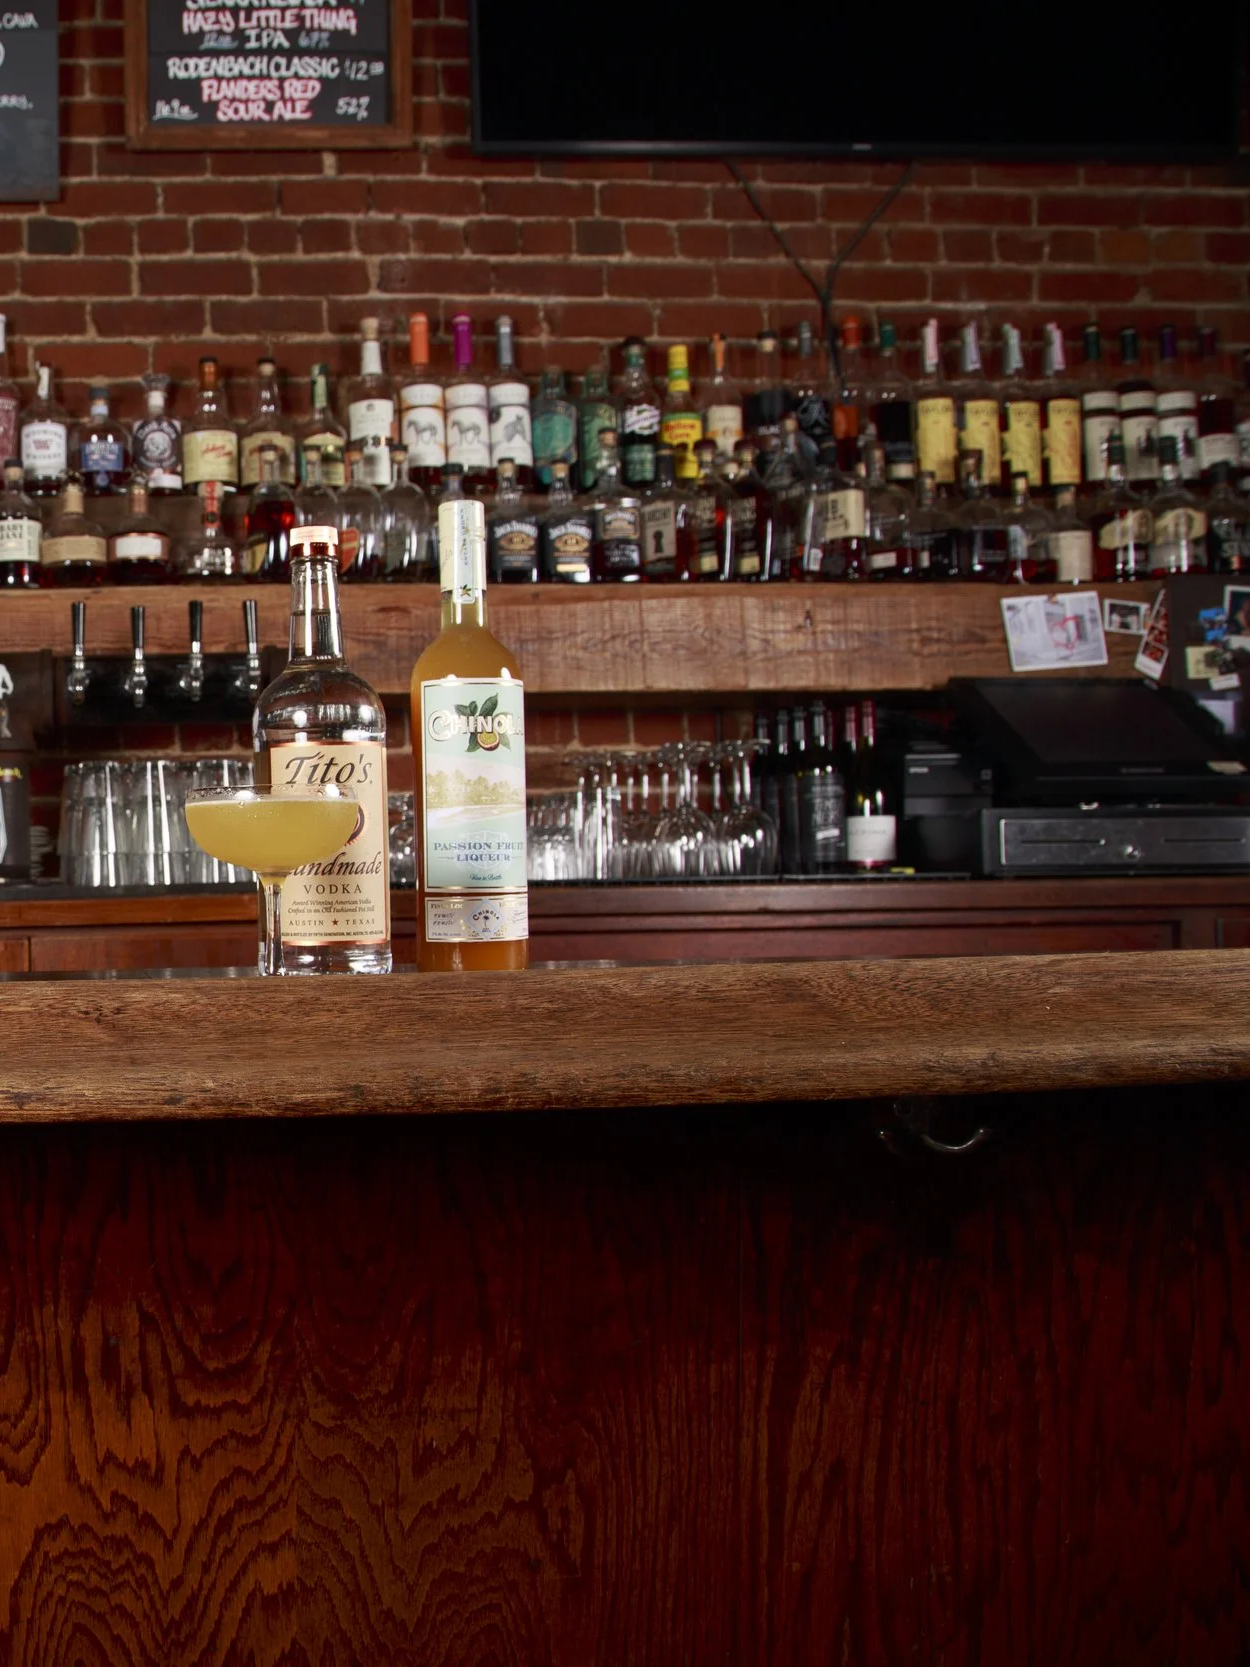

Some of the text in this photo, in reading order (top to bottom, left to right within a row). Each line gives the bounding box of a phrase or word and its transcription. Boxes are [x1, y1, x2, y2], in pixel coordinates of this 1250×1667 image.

[2, 11, 39, 30] CAVA
[182, 7, 358, 36] HAZY LITTLE THING
[244, 28, 290, 50] IPA
[166, 55, 269, 80] RODENBACH
[270, 55, 341, 80] CLASSIC
[200, 78, 322, 103] FLANDERS RED
[216, 100, 270, 122] SOUR
[272, 99, 313, 122] ALE
[285, 751, 372, 785] Tito's
[434, 842, 492, 851] PASSION
[289, 851, 382, 876] andmade
[456, 854, 510, 862] LIQUEUR
[303, 884, 362, 895] VODKA
[288, 907, 306, 915] Crafted
[332, 906, 357, 914] Fashioned
[309, 899, 334, 907] Winning
